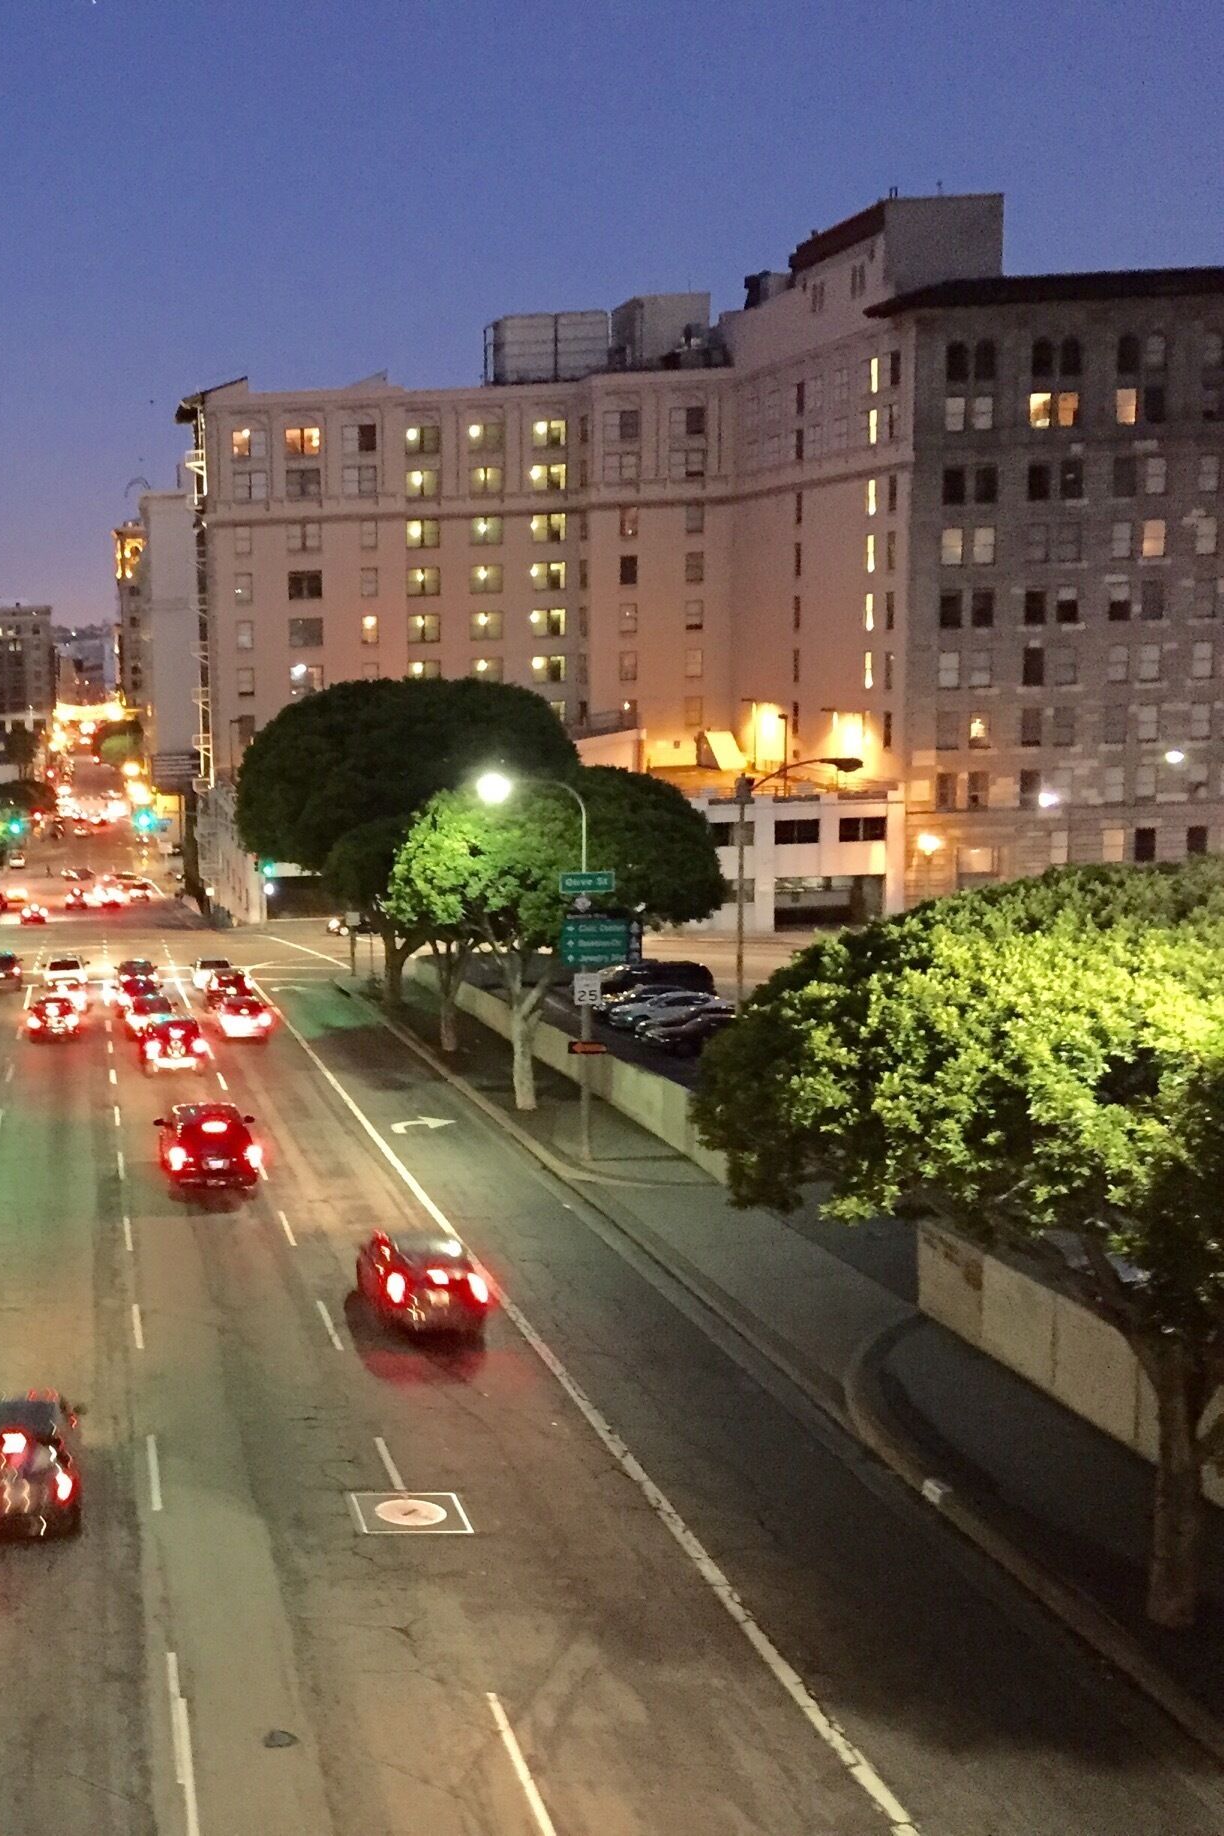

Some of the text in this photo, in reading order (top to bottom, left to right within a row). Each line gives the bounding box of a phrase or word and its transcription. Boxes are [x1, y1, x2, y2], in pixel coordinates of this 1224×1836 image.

[564, 877, 608, 887] Olive St
[577, 989, 598, 1002] 25
